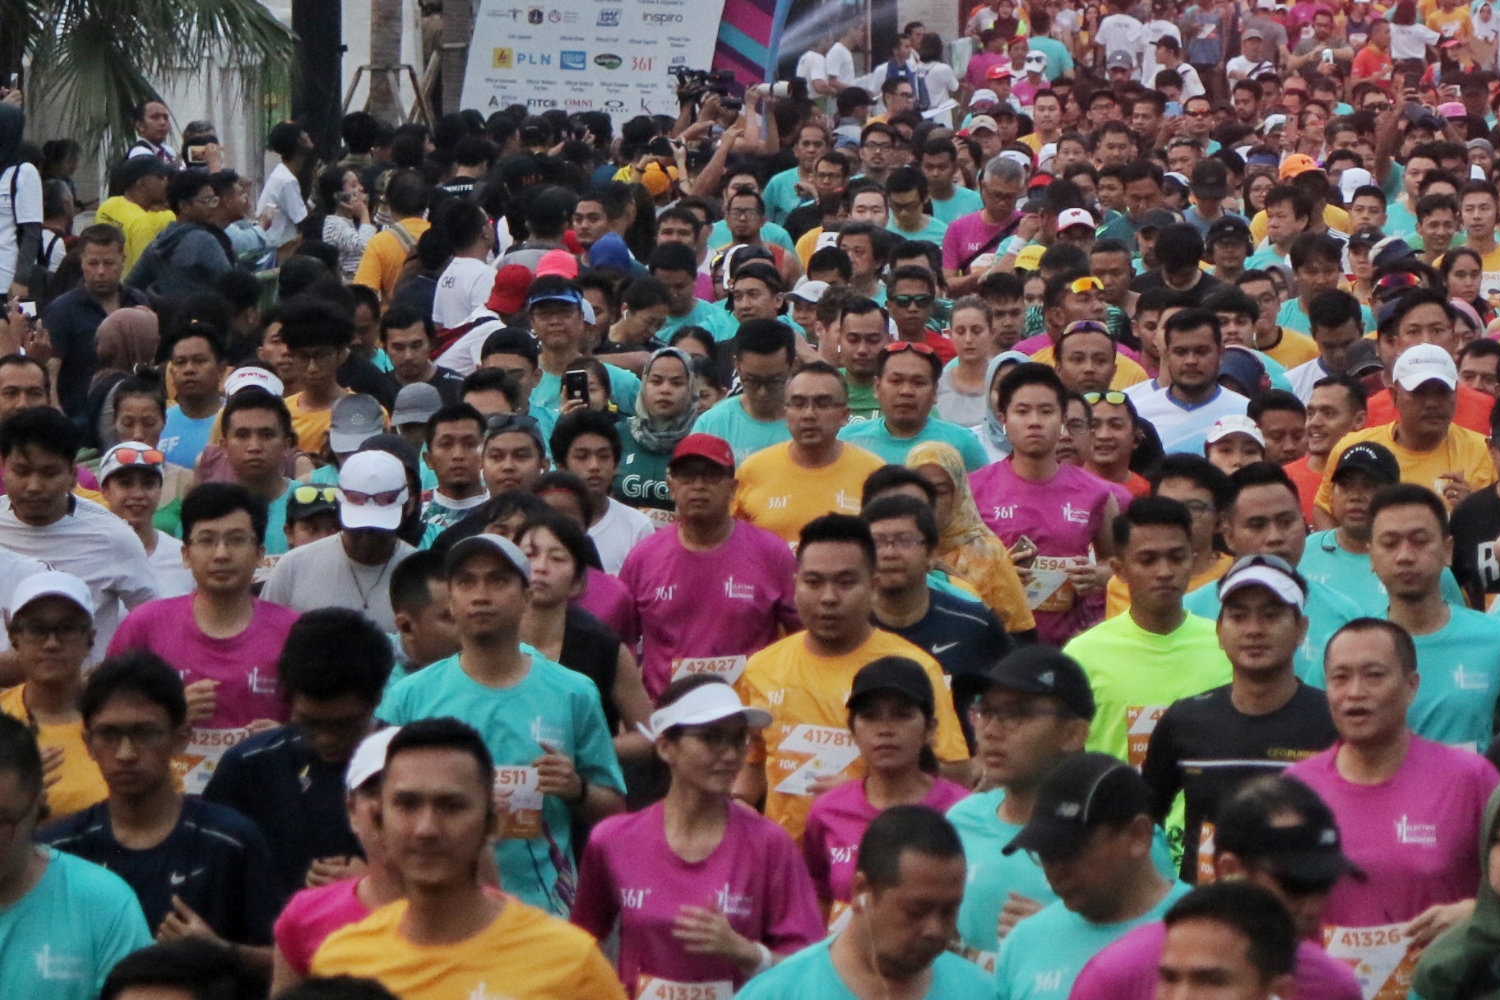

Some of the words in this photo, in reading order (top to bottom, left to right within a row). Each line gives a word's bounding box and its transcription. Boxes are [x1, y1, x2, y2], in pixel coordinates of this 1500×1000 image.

[643, 11, 683, 26] inspiro
[517, 52, 551, 66] PLN
[622, 473, 670, 500] Gra
[1033, 559, 1067, 571] 1594
[686, 658, 738, 674] 42427
[495, 769, 528, 785] 2511
[1341, 929, 1402, 948] 41326
